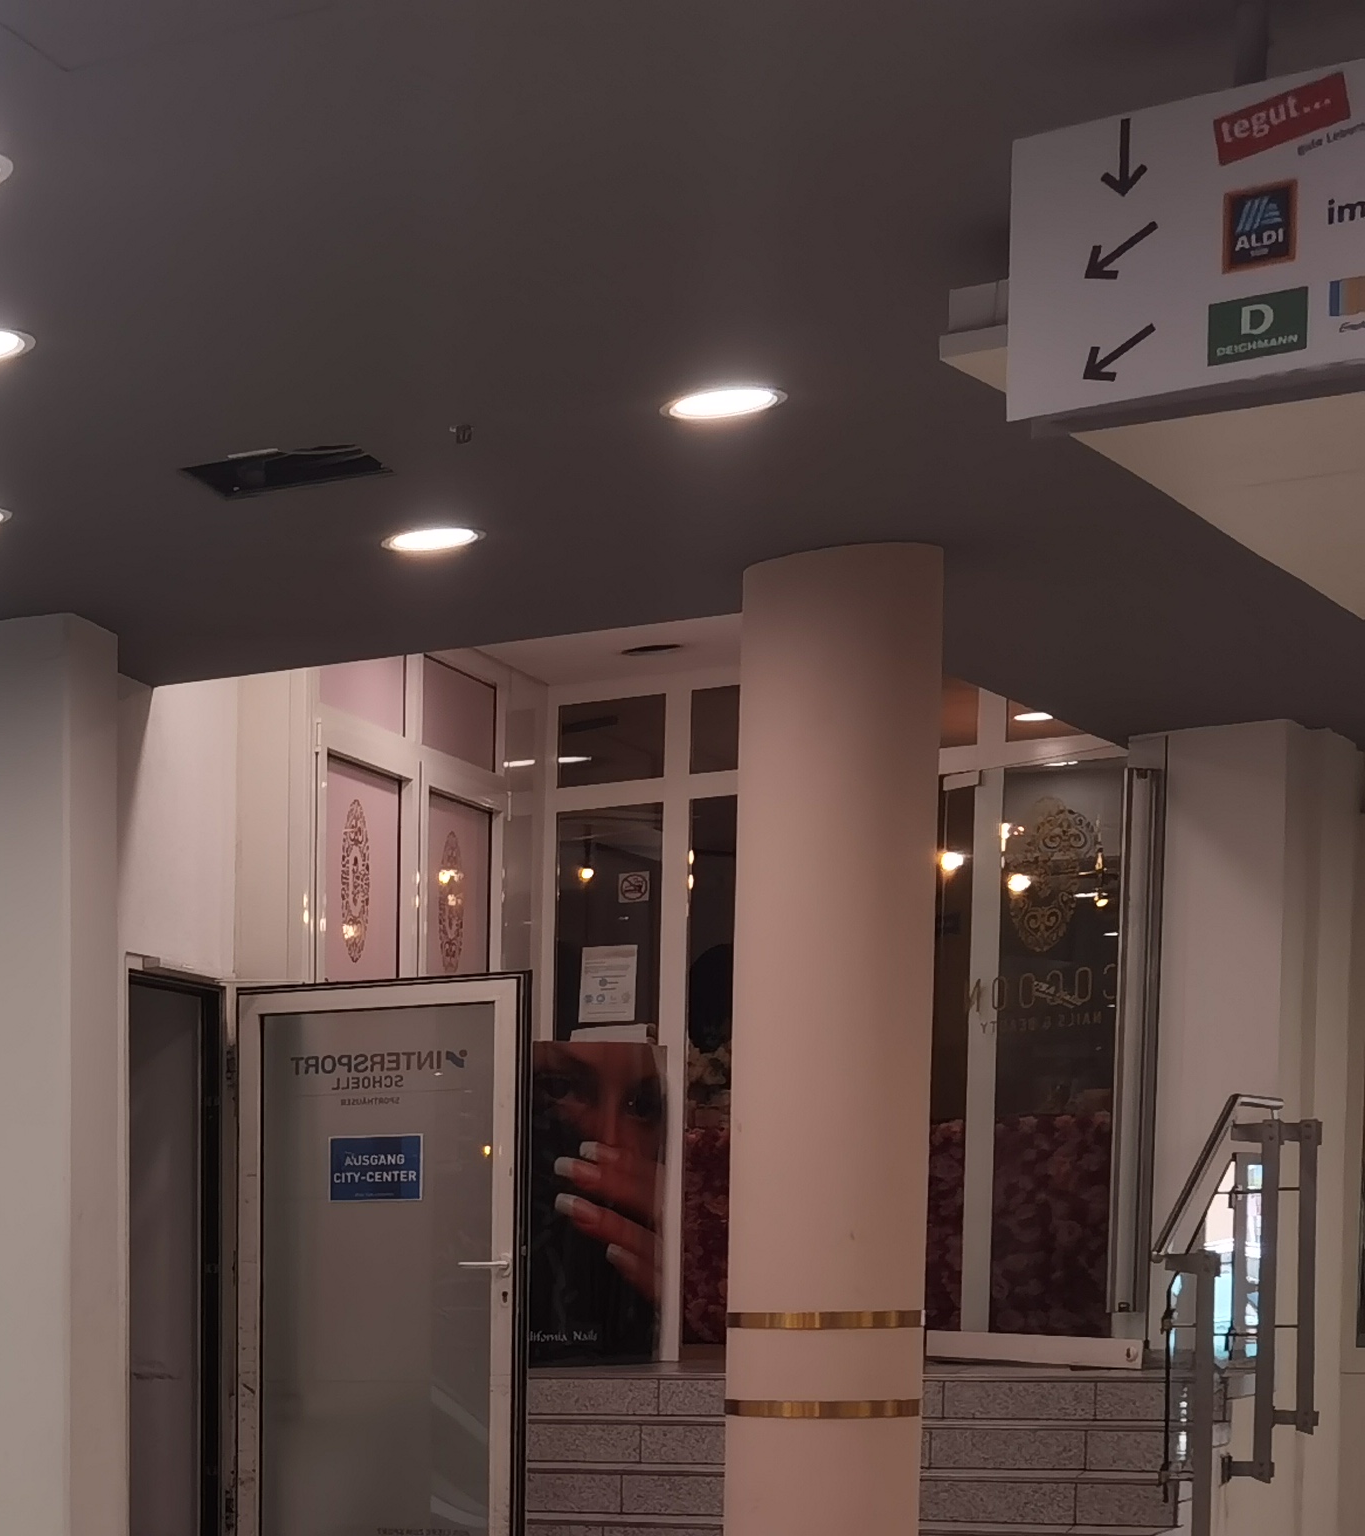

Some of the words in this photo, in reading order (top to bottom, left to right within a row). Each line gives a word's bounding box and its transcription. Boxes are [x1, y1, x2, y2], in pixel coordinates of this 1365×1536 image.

[1235, 228, 1284, 251] ALDI
[1216, 334, 1298, 356] DEICHMANN
[344, 1153, 406, 1167] AUSGANG
[333, 1170, 417, 1184] CITY-CENTER
[529, 1330, 568, 1342] lifornia
